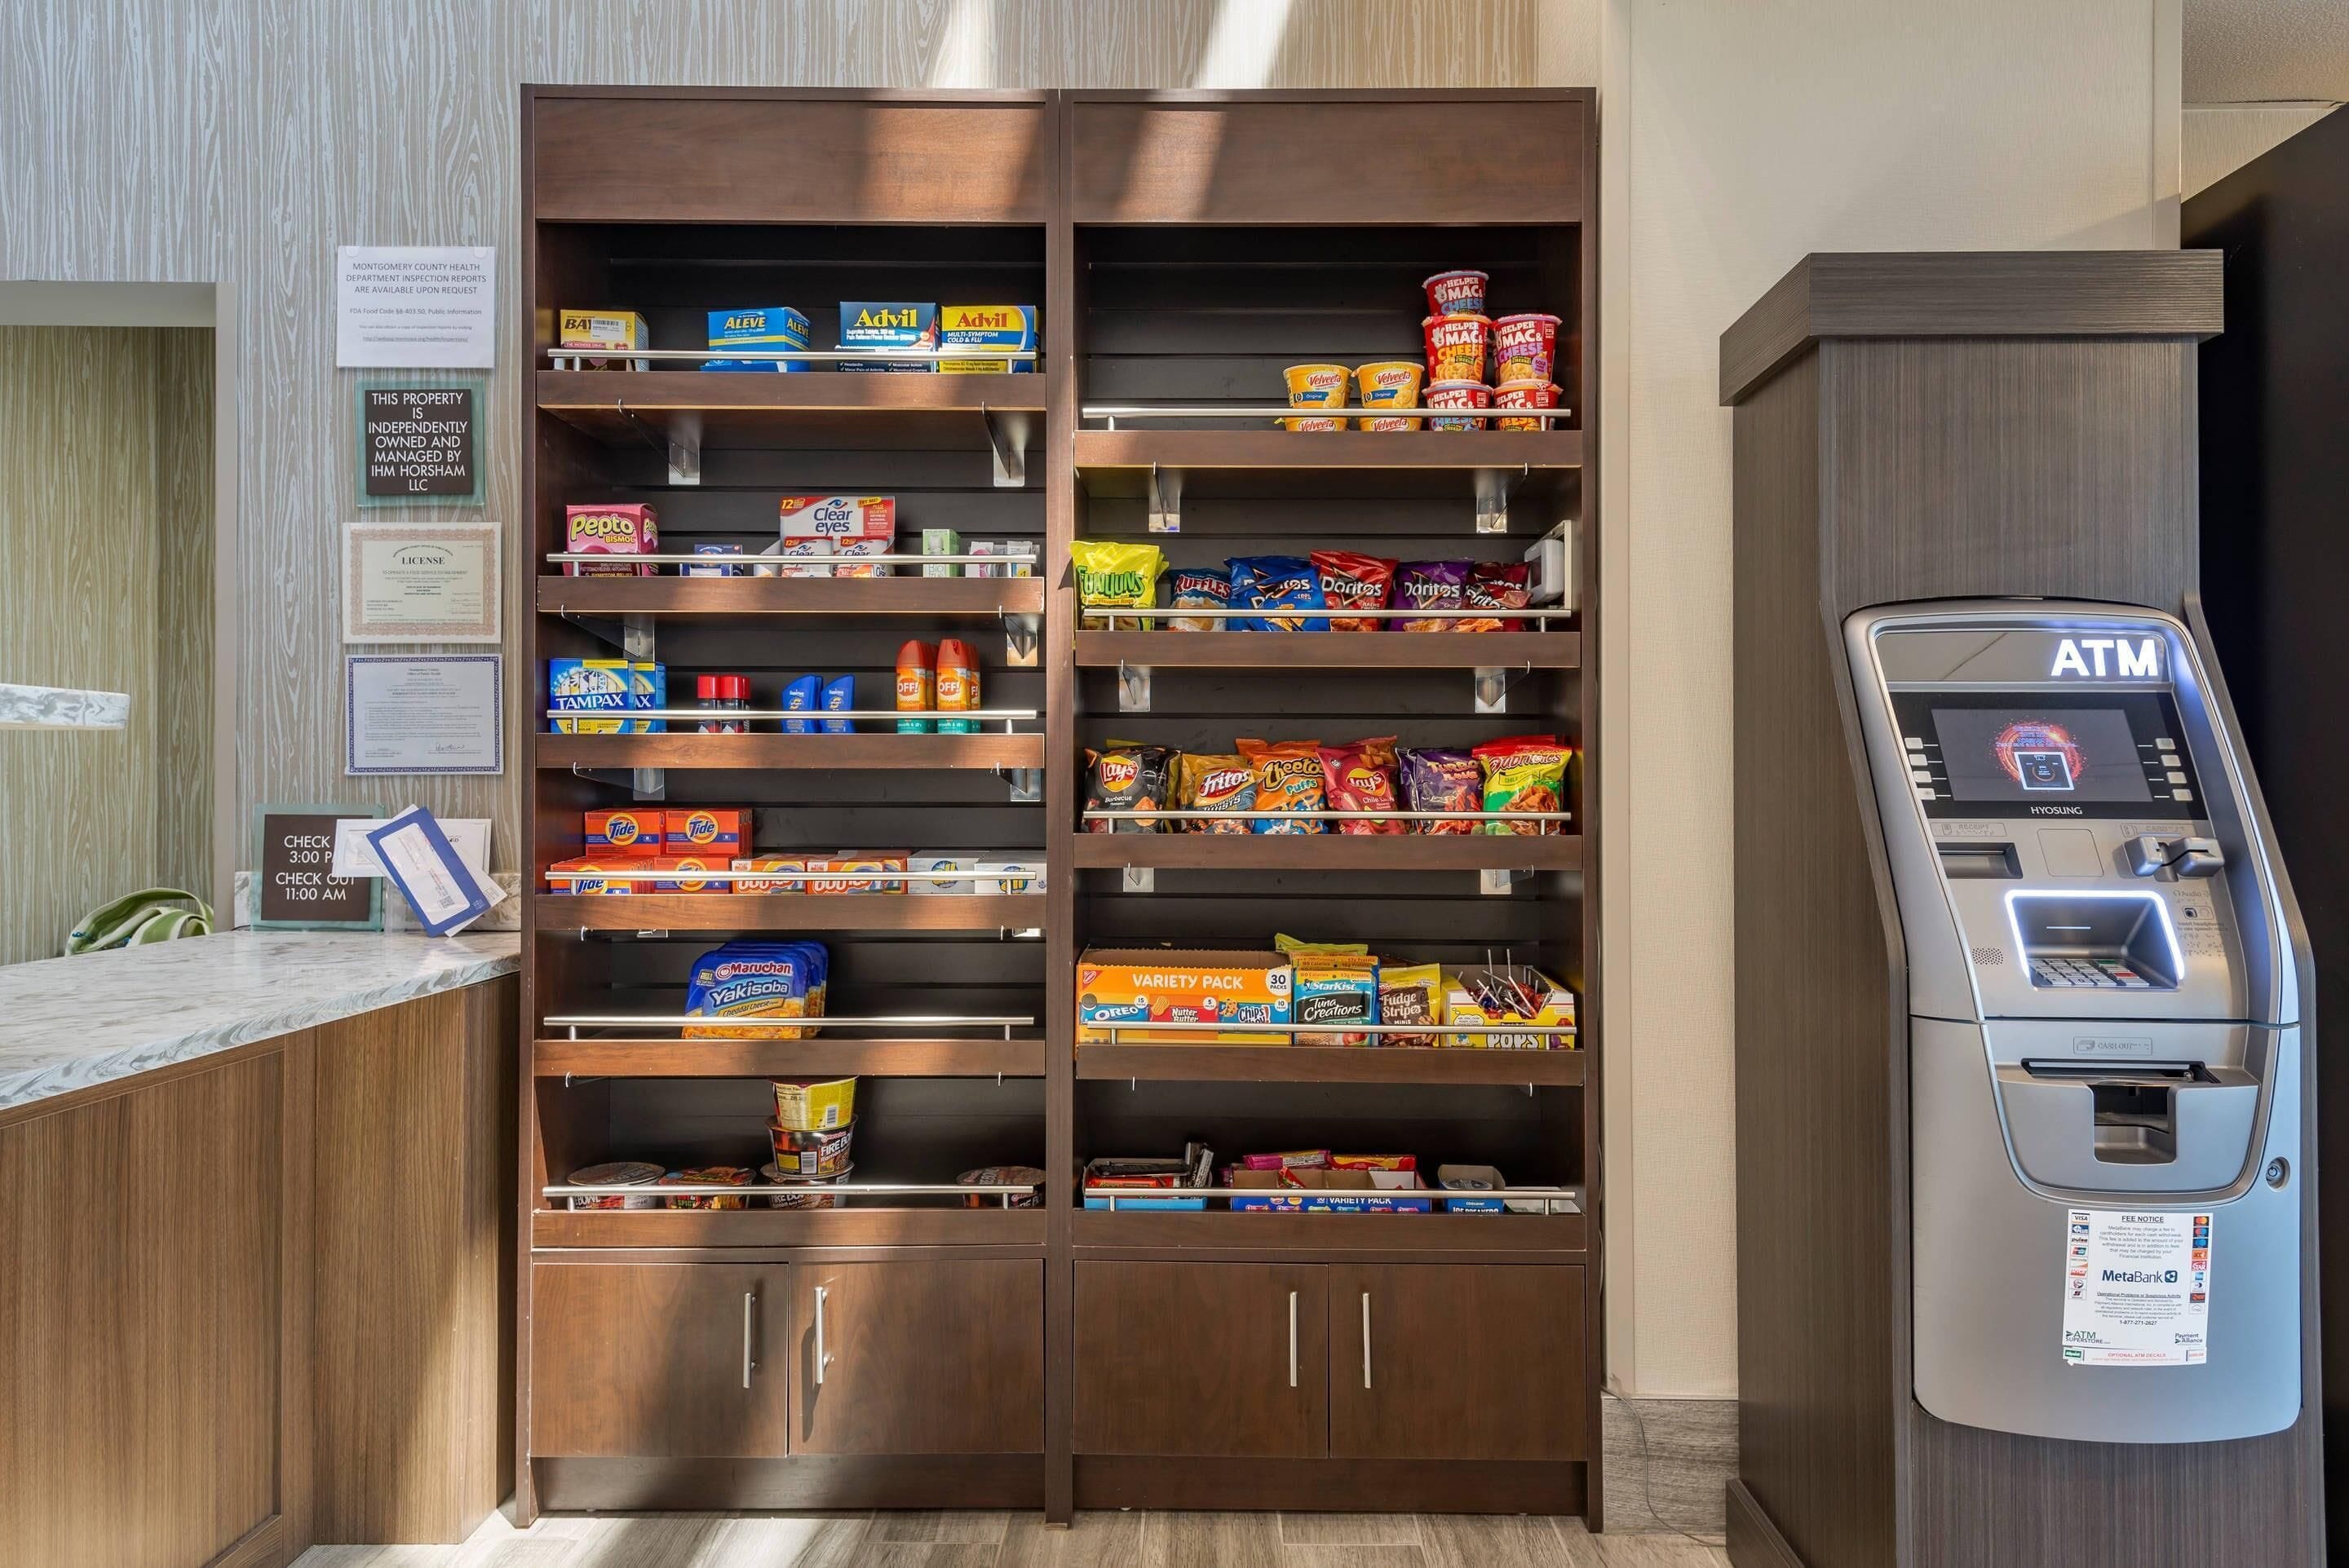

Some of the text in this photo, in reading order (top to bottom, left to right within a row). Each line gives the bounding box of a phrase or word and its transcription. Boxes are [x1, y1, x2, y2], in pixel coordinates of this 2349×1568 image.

[1447, 277, 1479, 288] HELPER
[1448, 288, 1479, 301] MAC
[724, 317, 766, 329] ALEVE
[855, 309, 917, 327] Advil
[956, 313, 1007, 327] Advil
[1445, 322, 1479, 331] HELPER
[1502, 321, 1535, 334] HELPER
[1446, 331, 1479, 345] MAC
[1503, 329, 1542, 348] MAC &
[1437, 345, 1483, 360] CHEESE
[1498, 342, 1543, 363] CHEESE
[1309, 373, 1342, 386] Velveeta
[1377, 372, 1411, 385] Velveeta
[372, 393, 462, 404] THIS PROPERTY
[1434, 390, 1467, 402] HELPER
[1435, 398, 1467, 409] MAC
[413, 408, 422, 418] IS
[369, 422, 467, 433] INDEPENDENTLY
[1300, 420, 1334, 431] Velveeta
[1374, 417, 1408, 431] Velveeta
[375, 436, 460, 448] OWNED AND
[375, 450, 461, 462] MANAGED BY
[372, 465, 465, 476] IHM HORSHAM
[409, 479, 428, 491] LLC
[781, 499, 793, 509] 12
[814, 508, 852, 521] Clear
[571, 515, 635, 541] Pepto
[816, 522, 850, 536] eyes
[1175, 575, 1232, 598] RUFFLES
[1320, 576, 1382, 596] Doritos
[1405, 581, 1460, 598] Doritos
[2050, 638, 2158, 677] ATM
[898, 682, 919, 692] OFF!
[939, 682, 960, 692] OFF!
[556, 693, 624, 710] TAMPAX
[1200, 769, 1250, 797] Fritos
[1285, 779, 1317, 796] Puffs
[1104, 795, 1132, 803] Barbecue
[2031, 806, 2083, 815] HYOSUNG
[609, 819, 636, 839] Tide
[688, 819, 715, 838] Tide
[1958, 823, 1989, 831] RECEIPT
[285, 836, 330, 848] CHECK
[290, 850, 319, 864] 3:00
[276, 872, 355, 886] CHECK OUT
[285, 888, 347, 900] 11:00 AM
[731, 962, 791, 974] Maruchan
[1132, 974, 1243, 989] VARIETY PACK
[1271, 974, 1285, 984] 30
[1312, 982, 1356, 990] StarKist
[710, 981, 788, 1005] Yakisoba
[1381, 992, 1416, 1005] Fudge
[723, 1001, 770, 1017] Cheddar Cheese
[1309, 997, 1337, 1009] Tuna
[1095, 1006, 1139, 1021] OREO
[1172, 1008, 1197, 1016] Nutter
[1238, 1007, 1264, 1022] Chips
[1304, 1004, 1363, 1021] Creations
[1382, 1005, 1422, 1018] Stripes
[1486, 1034, 1539, 1049] POPS
[2098, 1042, 2134, 1050] CASH OUT
[821, 1142, 840, 1156] FIRE
[821, 1150, 841, 1162] Ramen
[2121, 1215, 2136, 1223] FEE
[2102, 1270, 2163, 1283] MetaBank
[2073, 1331, 2096, 1339] ATM
